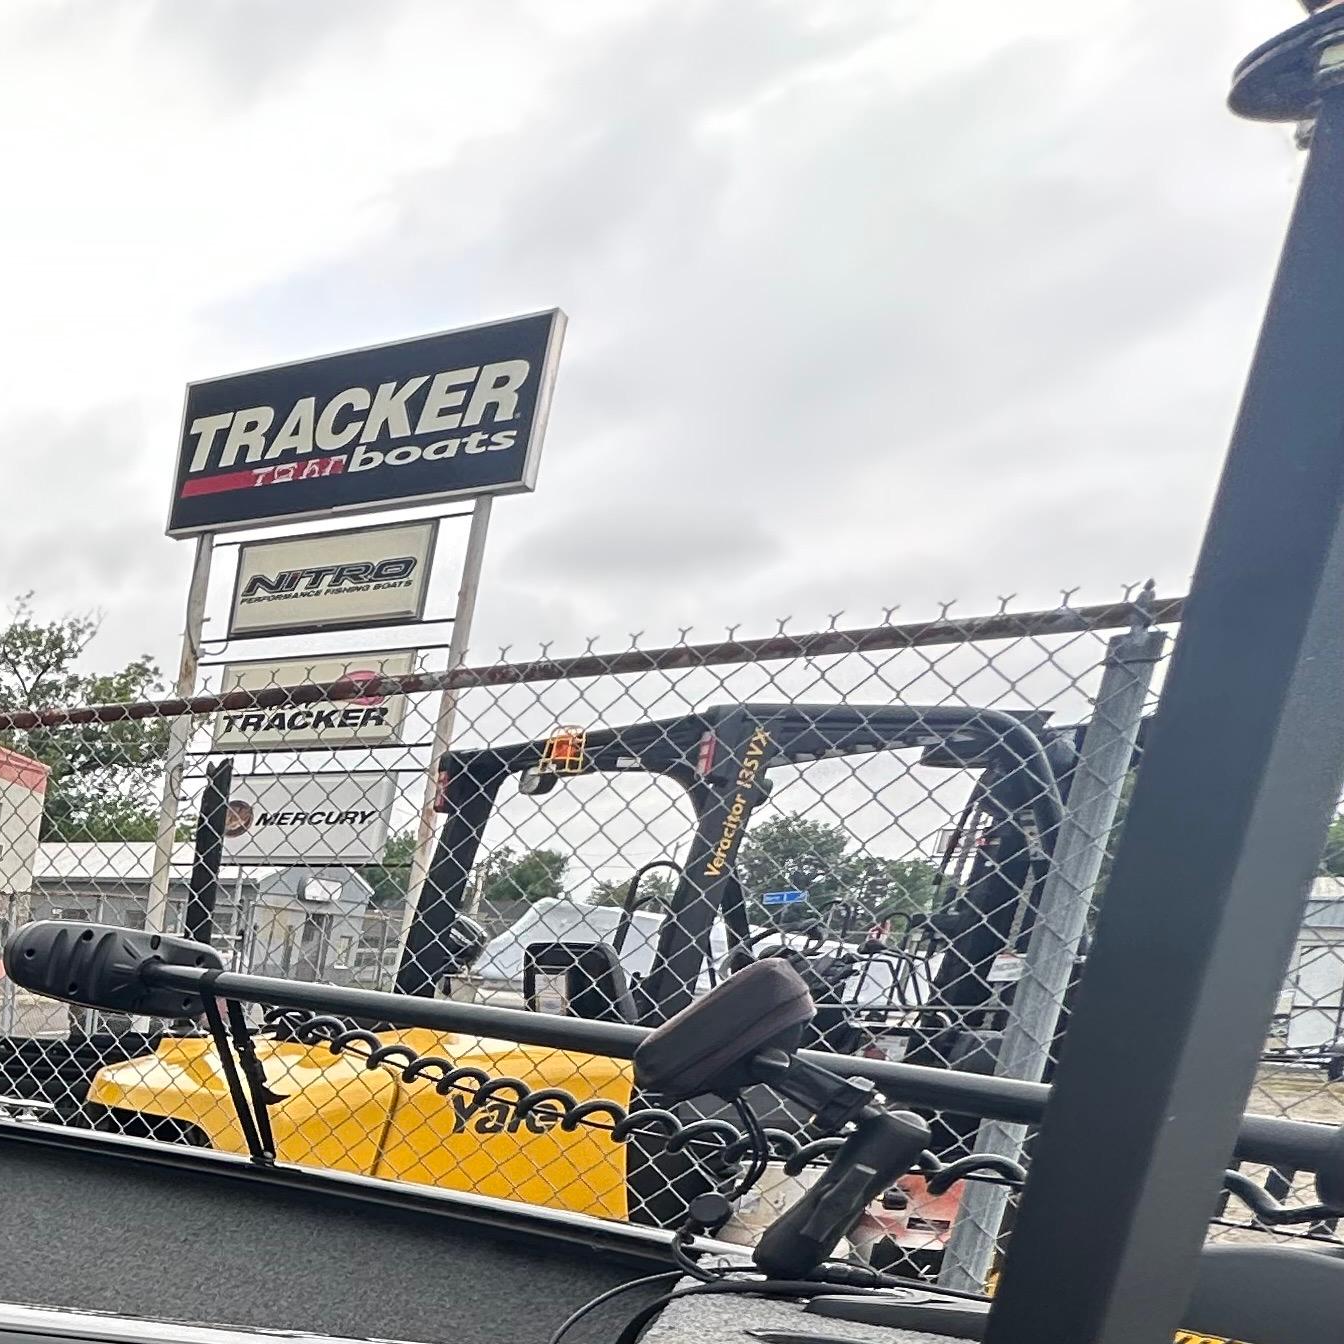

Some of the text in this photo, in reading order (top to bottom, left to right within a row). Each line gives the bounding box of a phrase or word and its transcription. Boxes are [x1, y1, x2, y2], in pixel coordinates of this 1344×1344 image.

[189, 360, 530, 472] TRACKER
[347, 428, 517, 473] boats
[241, 556, 418, 597] NITRO
[373, 580, 414, 591] BOATS
[223, 707, 389, 733] TRACKER
[255, 810, 377, 827] MERCURY
